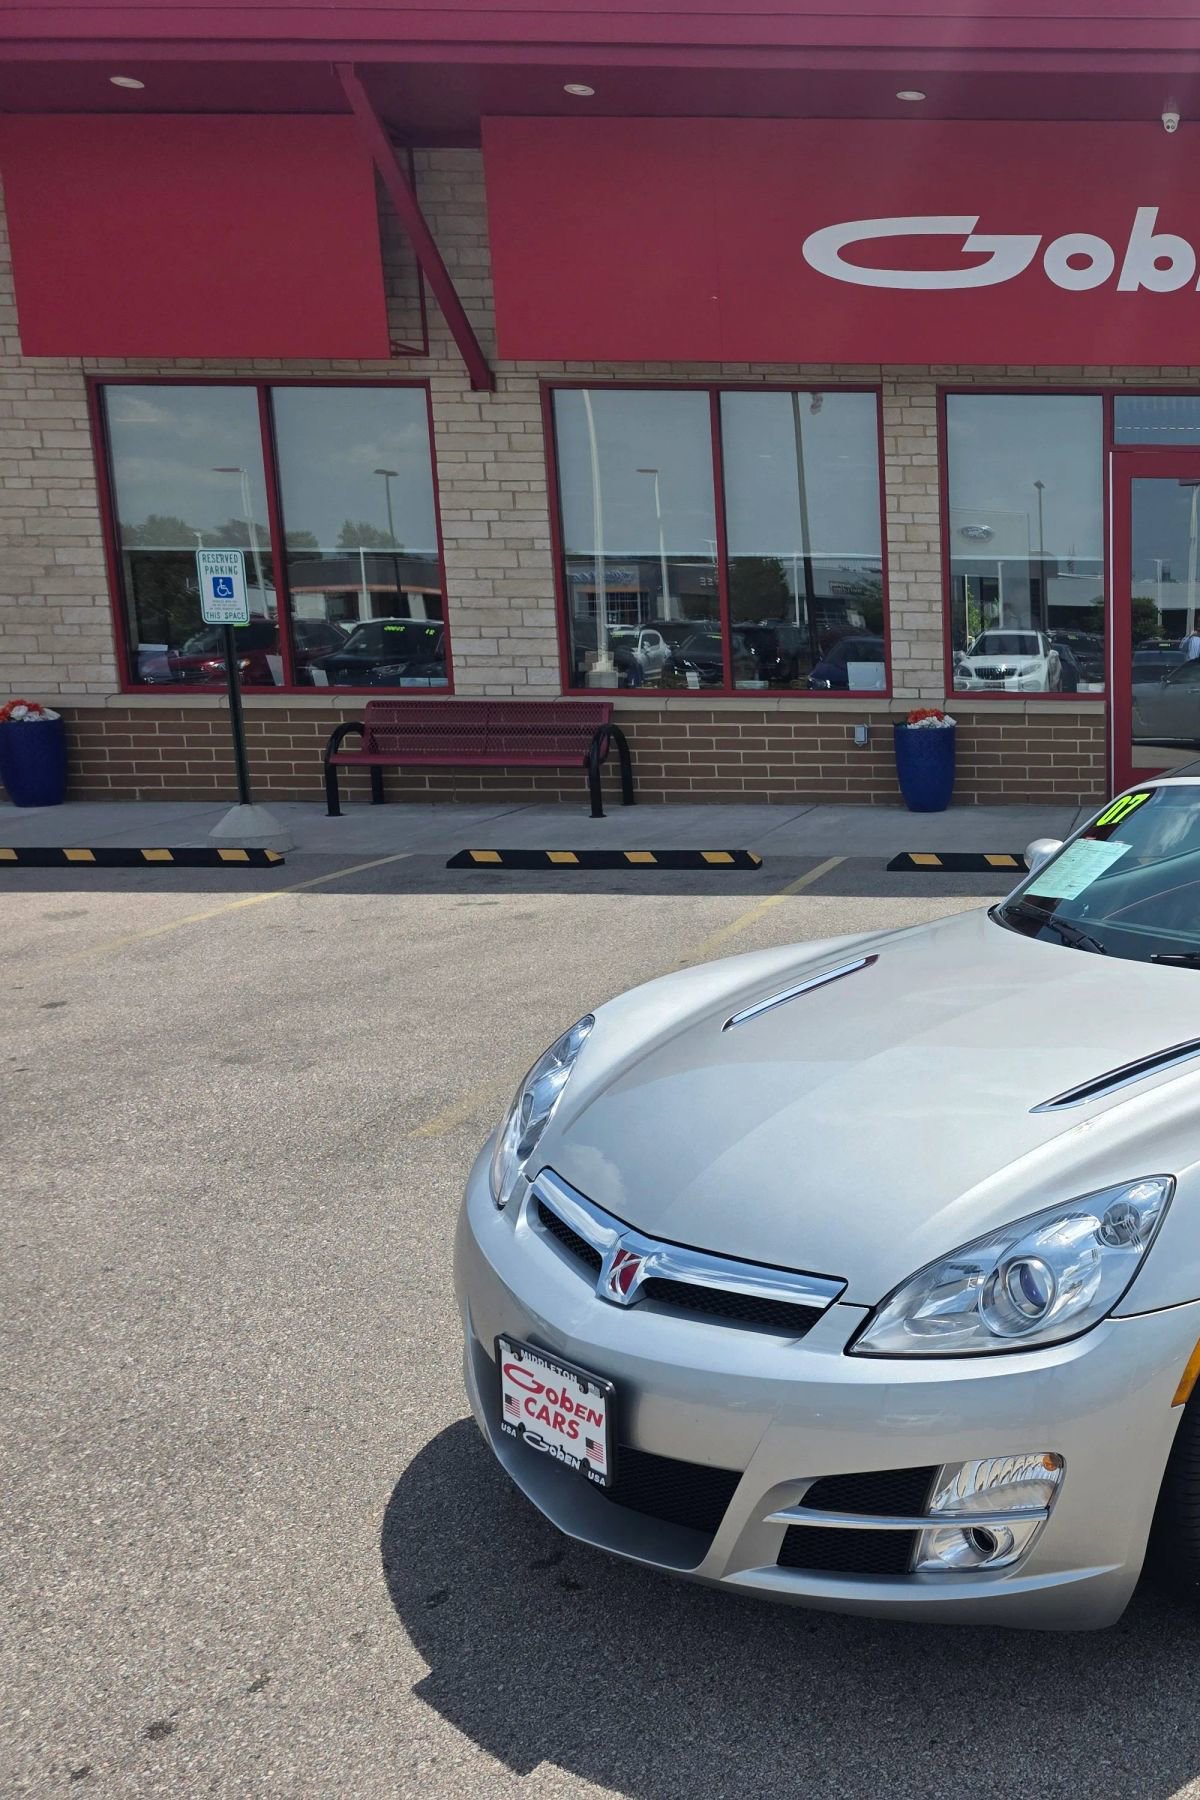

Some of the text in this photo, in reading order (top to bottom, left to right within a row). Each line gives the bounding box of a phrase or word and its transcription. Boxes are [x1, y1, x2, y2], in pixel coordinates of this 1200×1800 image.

[202, 553, 239, 564] RESERVED
[205, 565, 238, 576] PARKING
[206, 611, 246, 620] THIS SPACE
[1096, 793, 1150, 827] 07
[520, 1349, 579, 1383] MIDDLETON
[524, 1397, 580, 1440] CARS
[501, 1422, 517, 1438] USA
[587, 1470, 606, 1487] USA
